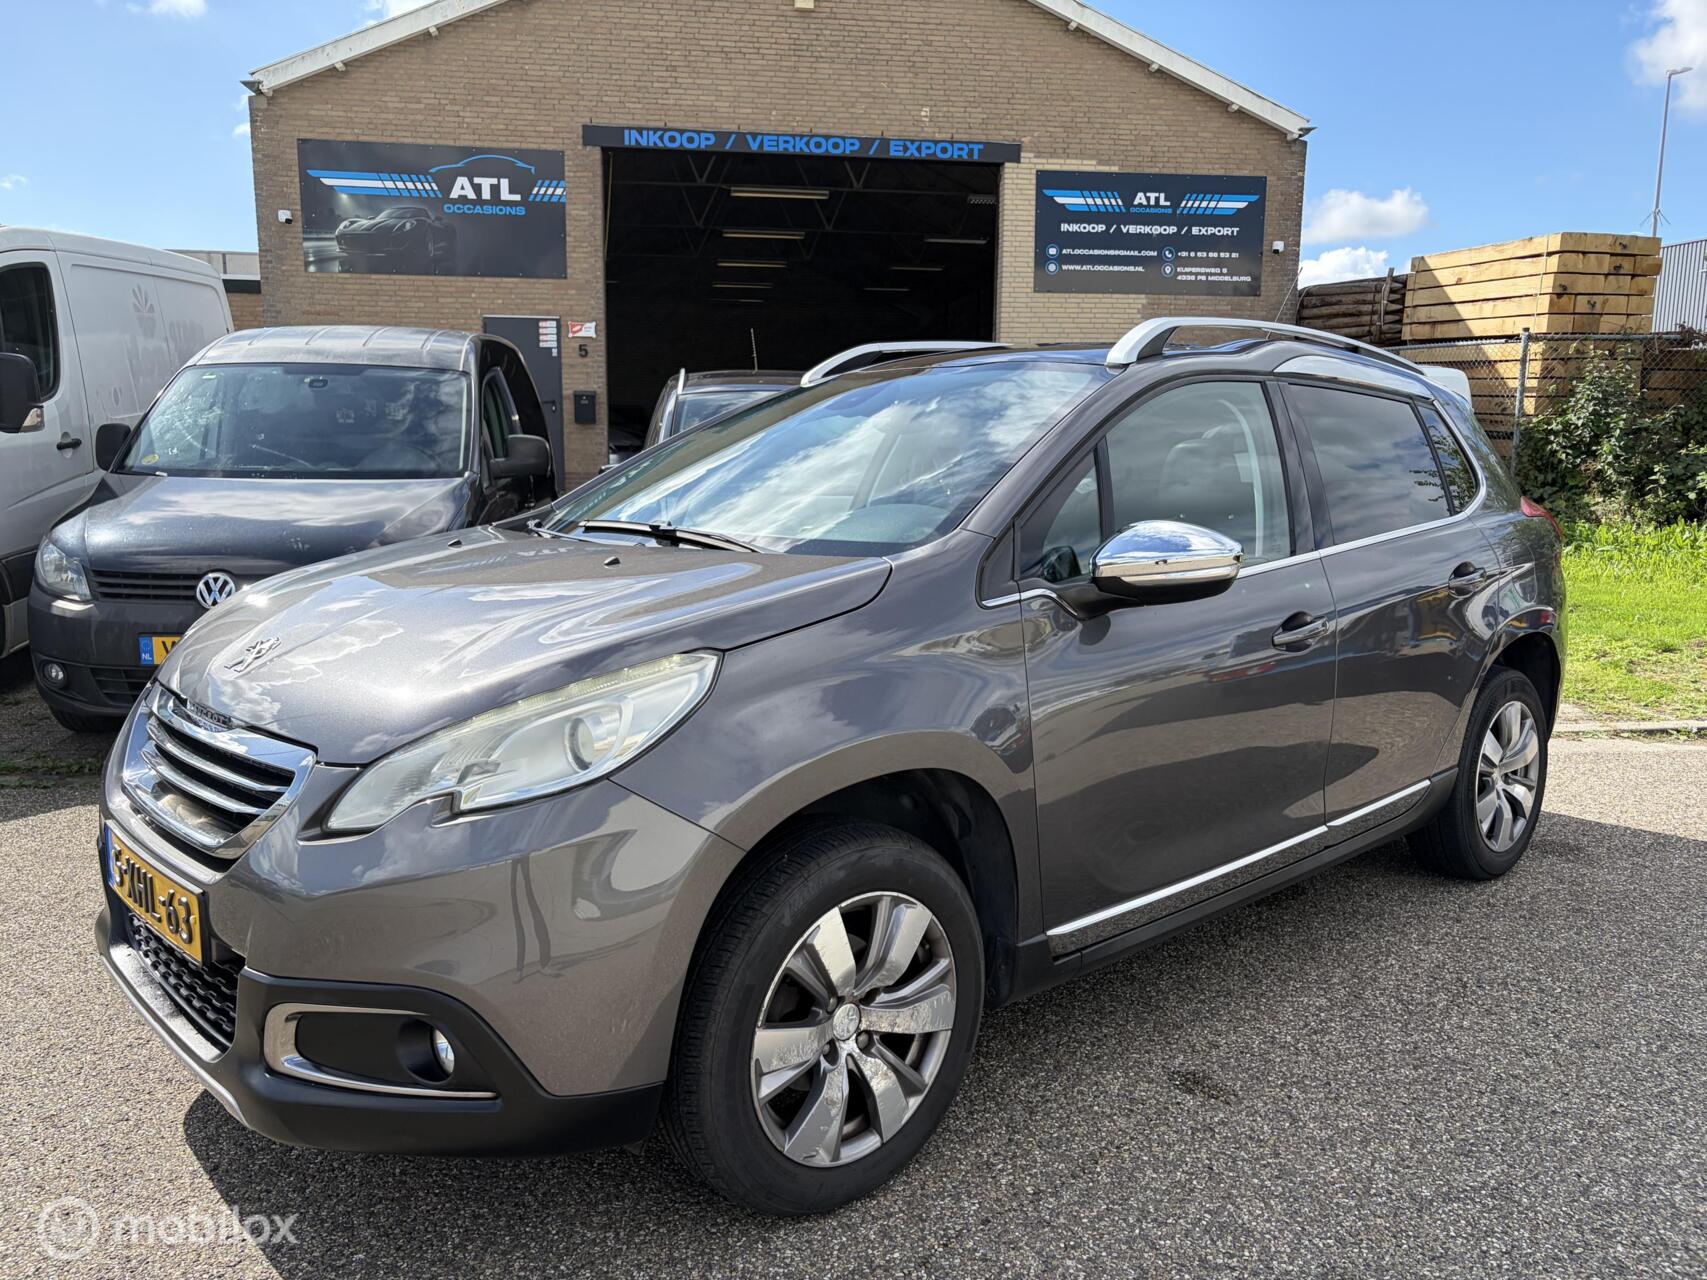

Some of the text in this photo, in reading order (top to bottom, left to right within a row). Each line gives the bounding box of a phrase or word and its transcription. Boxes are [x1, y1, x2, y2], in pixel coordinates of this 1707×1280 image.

[623, 129, 984, 160] INKOOP / VERKOOP / EXPORT
[450, 176, 521, 201] ATL
[1133, 192, 1171, 206] ATL
[443, 203, 526, 216] OCCASIONS
[1060, 223, 1106, 233] INKOOP
[1121, 225, 1178, 235] VERKOOP
[1192, 226, 1240, 236] EXPORT
[578, 344, 588, 358] 5
